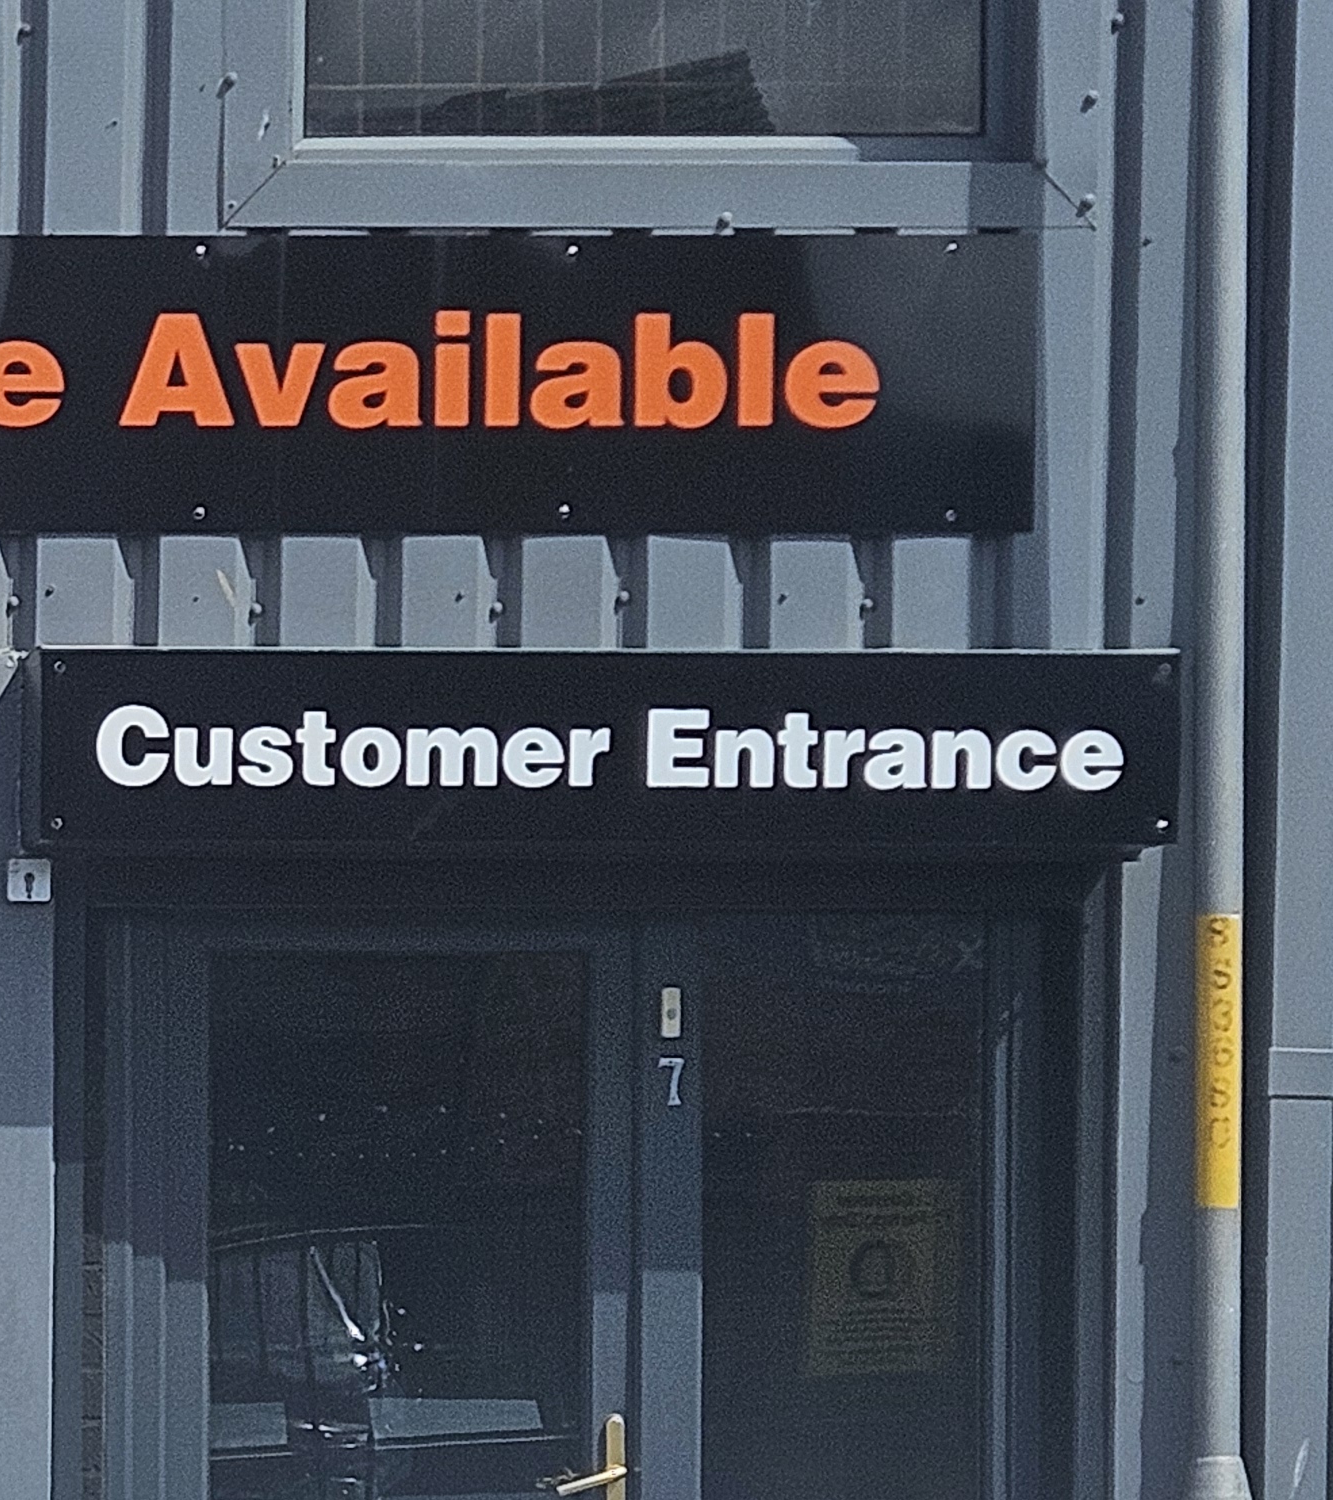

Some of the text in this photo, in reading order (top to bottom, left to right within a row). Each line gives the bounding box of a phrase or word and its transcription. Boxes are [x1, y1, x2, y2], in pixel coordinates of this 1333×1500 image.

[119, 310, 880, 429] Available
[95, 704, 1124, 791] Customer Entrance
[659, 1055, 685, 1108] 7
